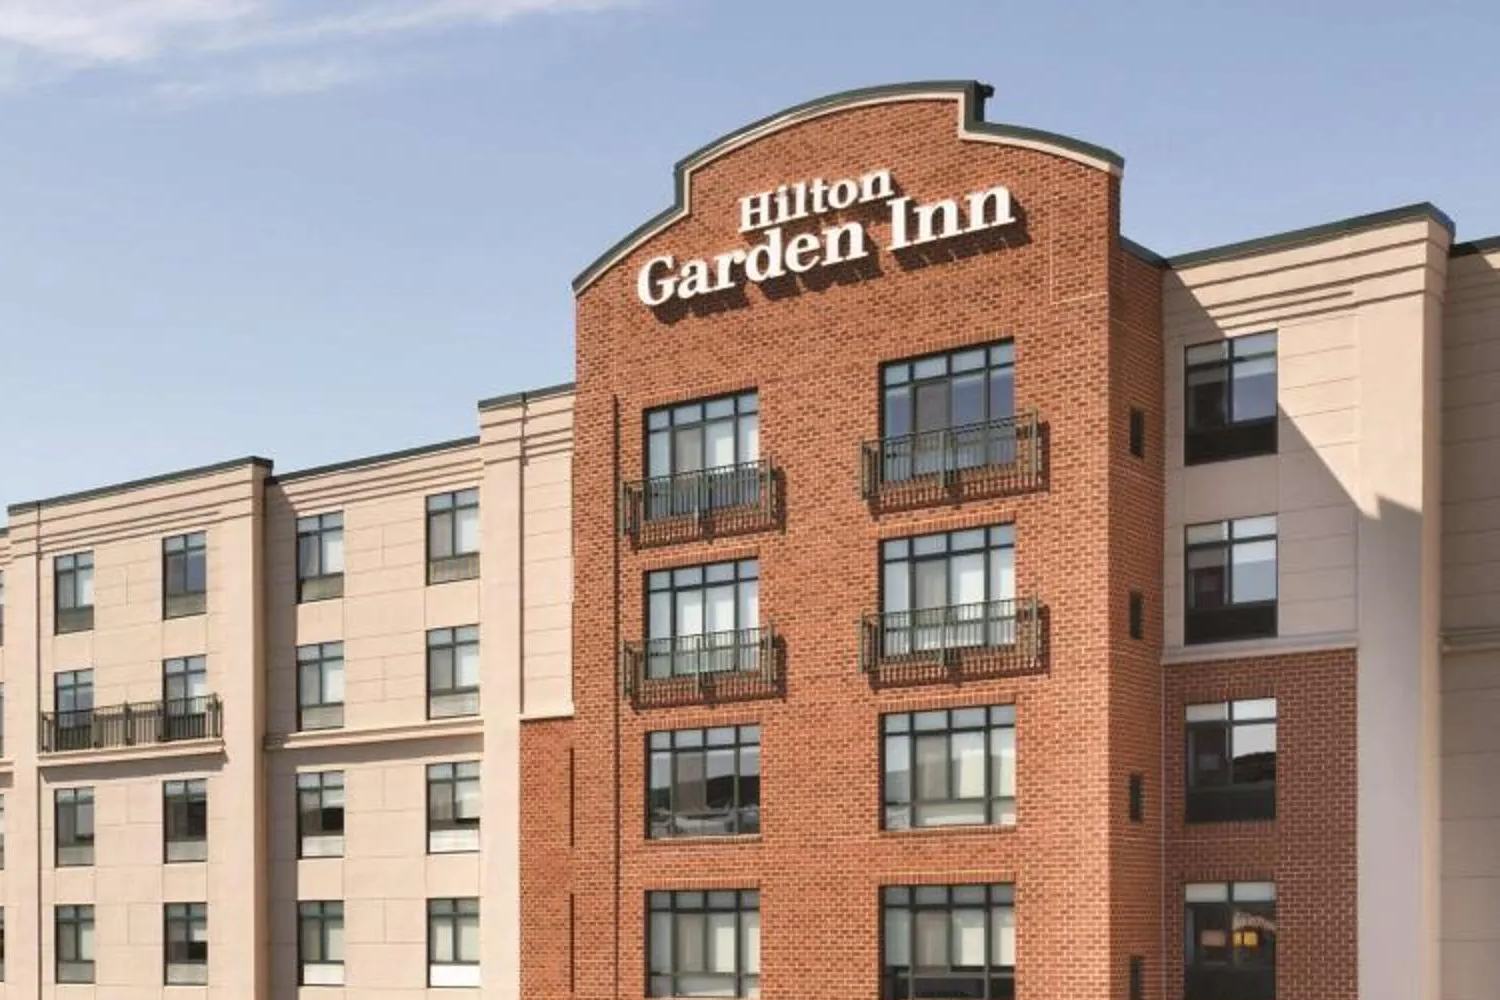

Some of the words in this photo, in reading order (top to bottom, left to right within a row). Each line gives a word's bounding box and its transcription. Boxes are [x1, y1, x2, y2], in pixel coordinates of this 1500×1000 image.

[636, 219, 869, 308] Garden
[886, 185, 1017, 252] Inn
[738, 168, 896, 234] Hilton
